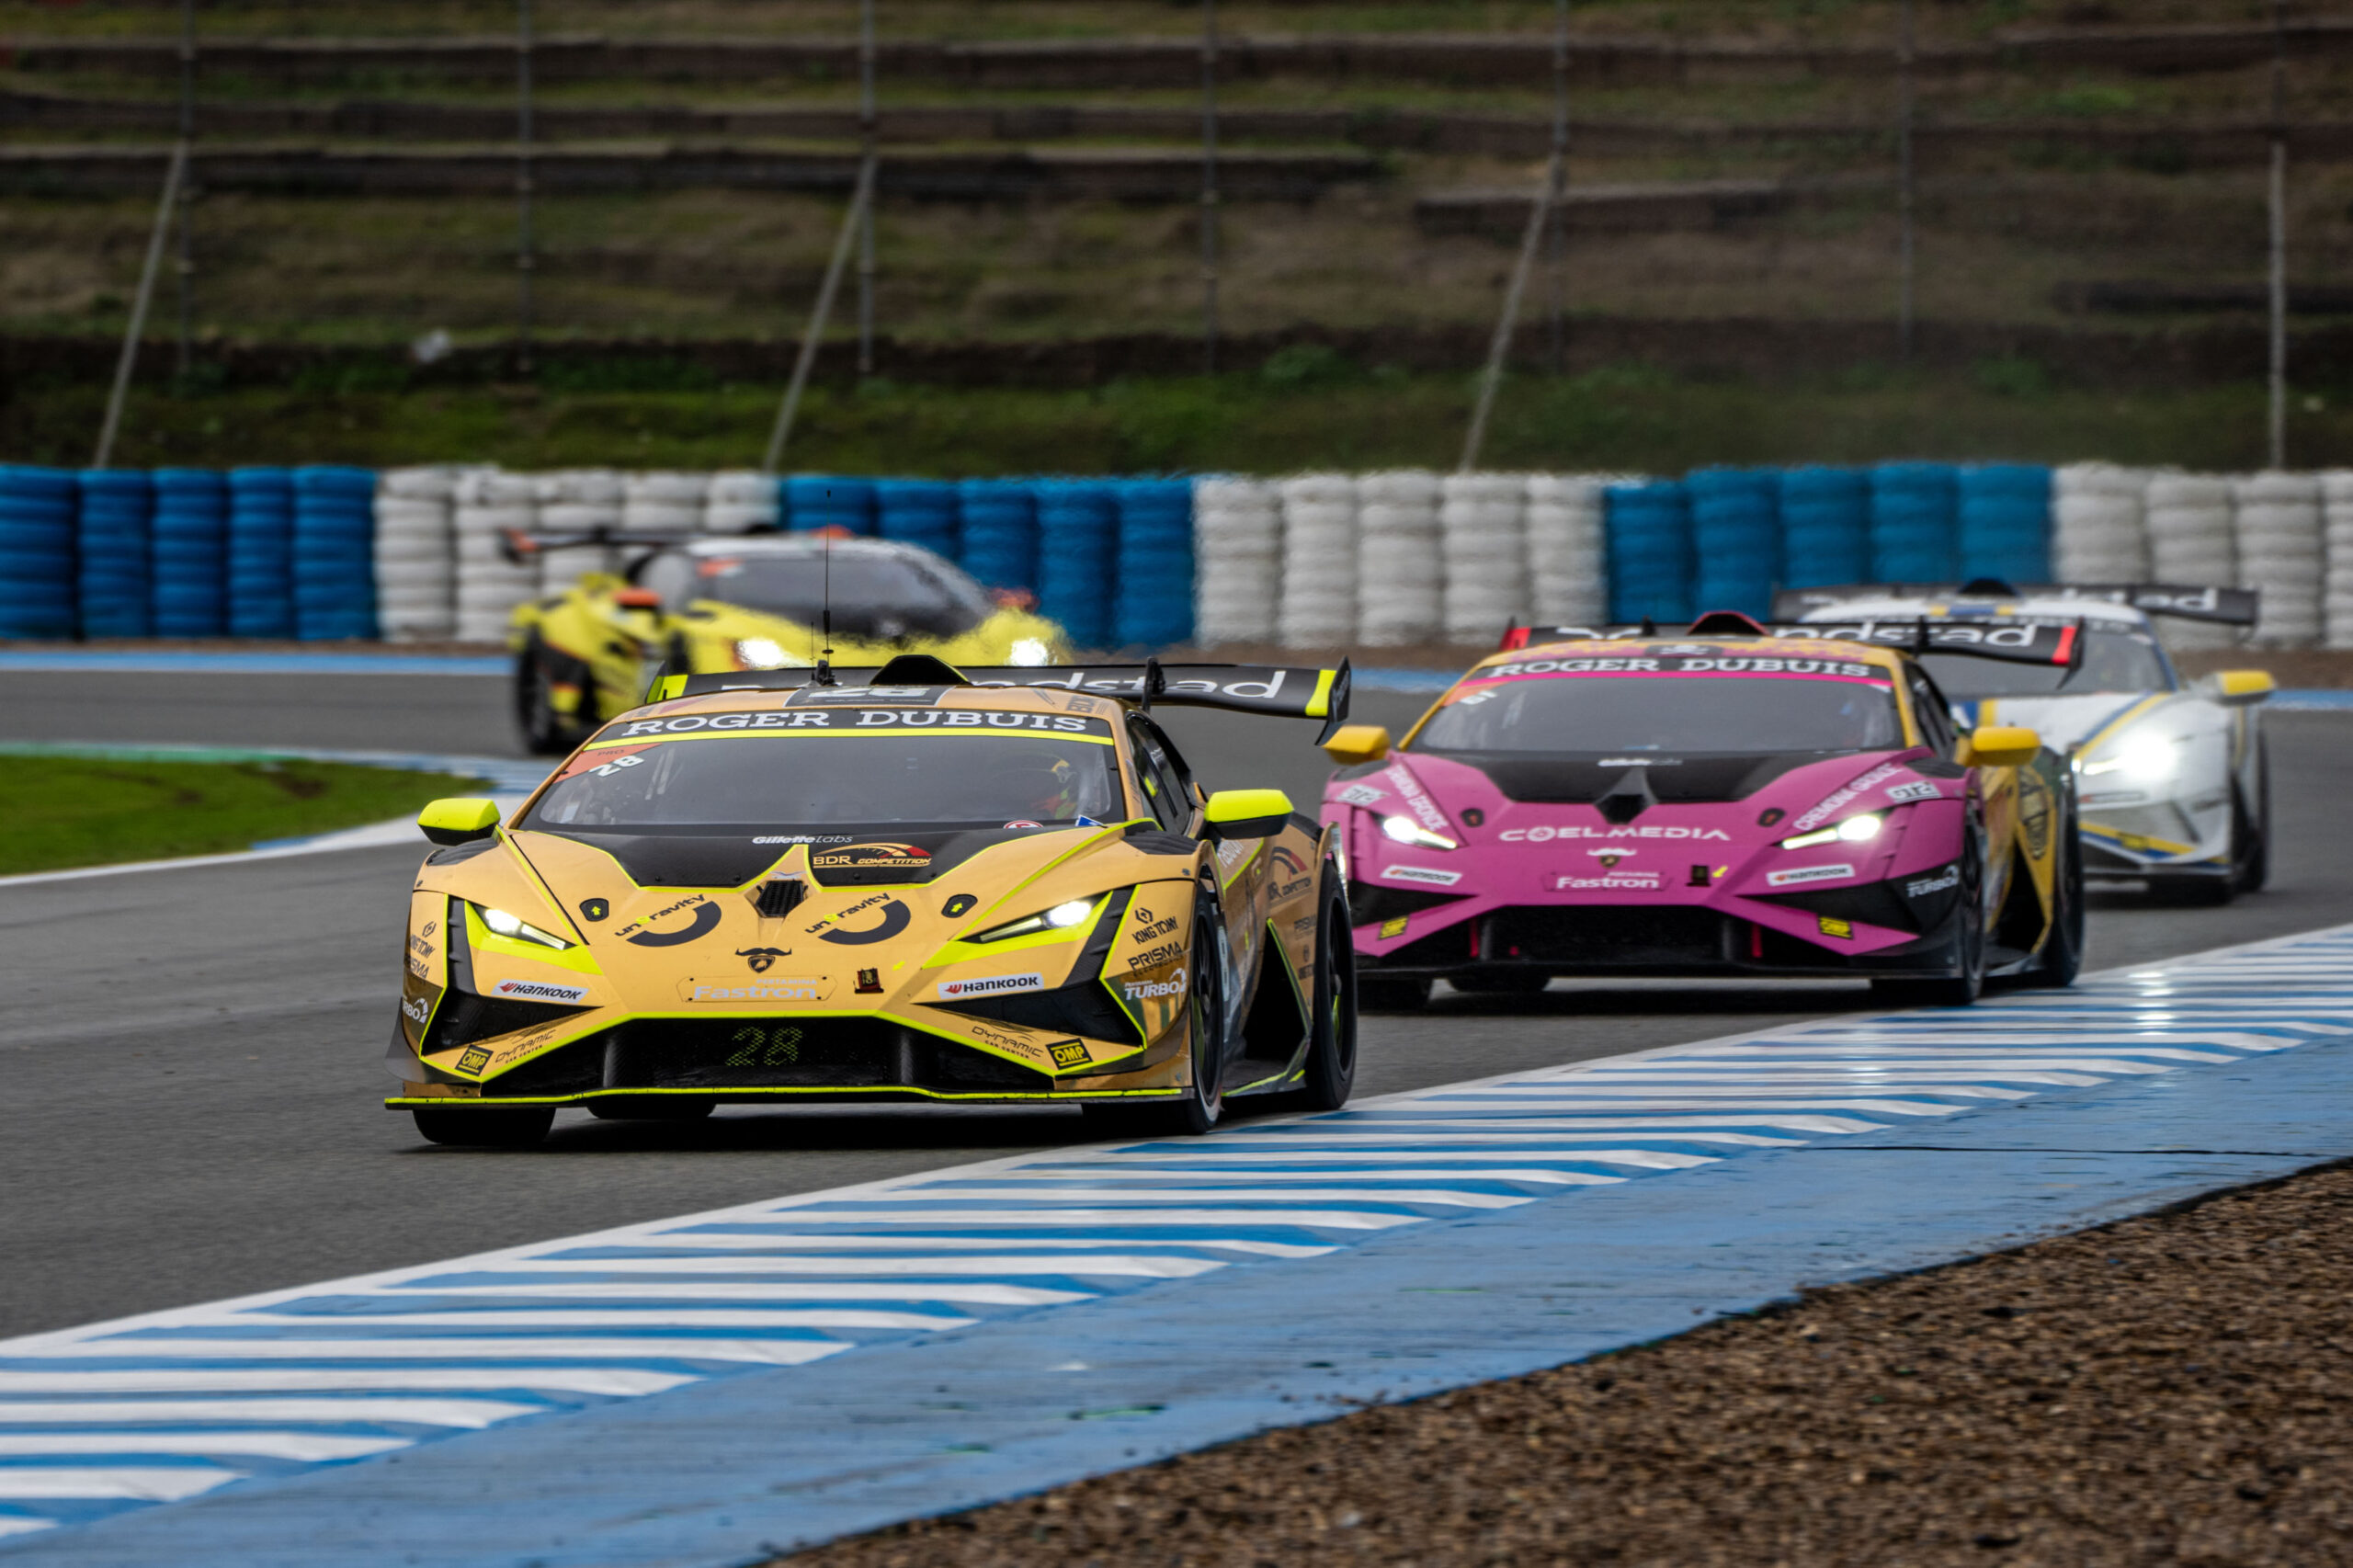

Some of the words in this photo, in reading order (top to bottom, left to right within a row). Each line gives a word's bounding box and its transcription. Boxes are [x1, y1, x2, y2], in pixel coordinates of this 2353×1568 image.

[1771, 622, 2037, 648] ndsad
[1489, 658, 1659, 678] ROGER
[1680, 656, 1870, 677] DUBUIS
[622, 711, 830, 736] ROGER
[855, 711, 1086, 733] DUBUIS
[588, 756, 644, 778] 28
[1499, 826, 1731, 842] COELMEDIA
[813, 856, 854, 865] BDR
[1557, 876, 1660, 890] Fastron
[1132, 926, 1158, 945] KING
[1154, 916, 1179, 935] TONY
[1127, 941, 1183, 972] PRISMA
[694, 985, 816, 999] Fastron
[1124, 981, 1179, 1001] TURBO
[494, 1028, 557, 1063] DYNAMIC
[725, 1025, 803, 1066] 28
[972, 1026, 1044, 1058] DYNAMIC
[461, 1052, 487, 1069] OMP
[1053, 1046, 1085, 1062] OMP
